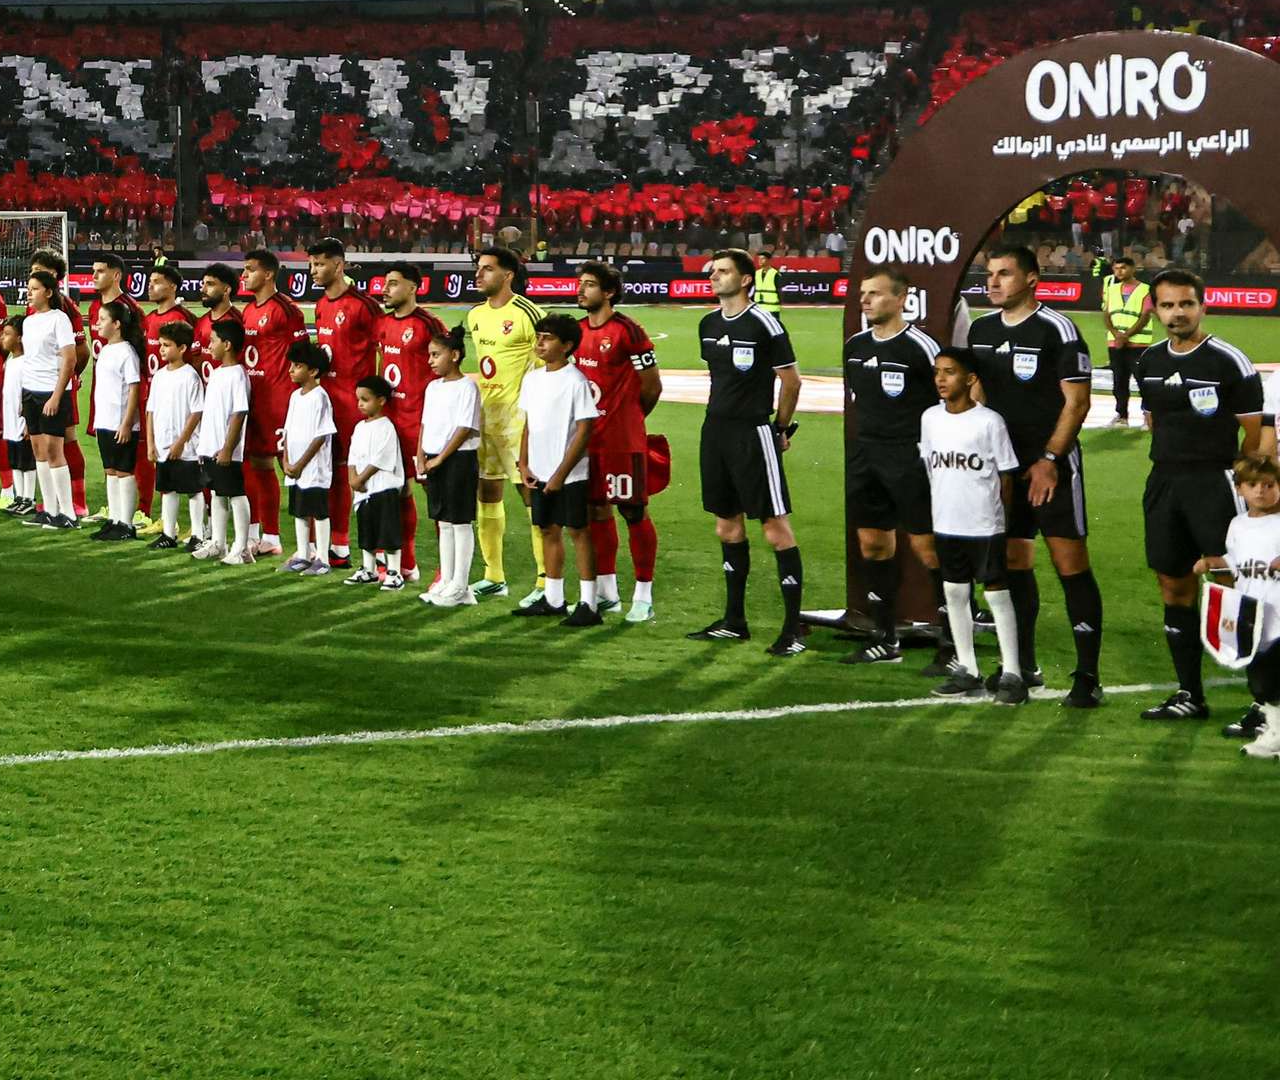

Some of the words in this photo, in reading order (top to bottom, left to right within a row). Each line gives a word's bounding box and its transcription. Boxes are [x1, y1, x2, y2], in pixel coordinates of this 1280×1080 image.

[1024, 51, 1208, 122] ONIRO
[992, 135, 1052, 159] الزمالك
[1056, 133, 1107, 161] لنادي
[1111, 130, 1182, 159] الرسمي
[1187, 128, 1249, 159] الراعي
[864, 225, 960, 265] ONIRO
[673, 283, 711, 294] UNITE
[781, 281, 829, 295] للرياض
[1205, 291, 1272, 305] UNITED
[641, 353, 653, 366] C
[931, 449, 985, 471] ONIRO
[605, 473, 633, 500] 30
